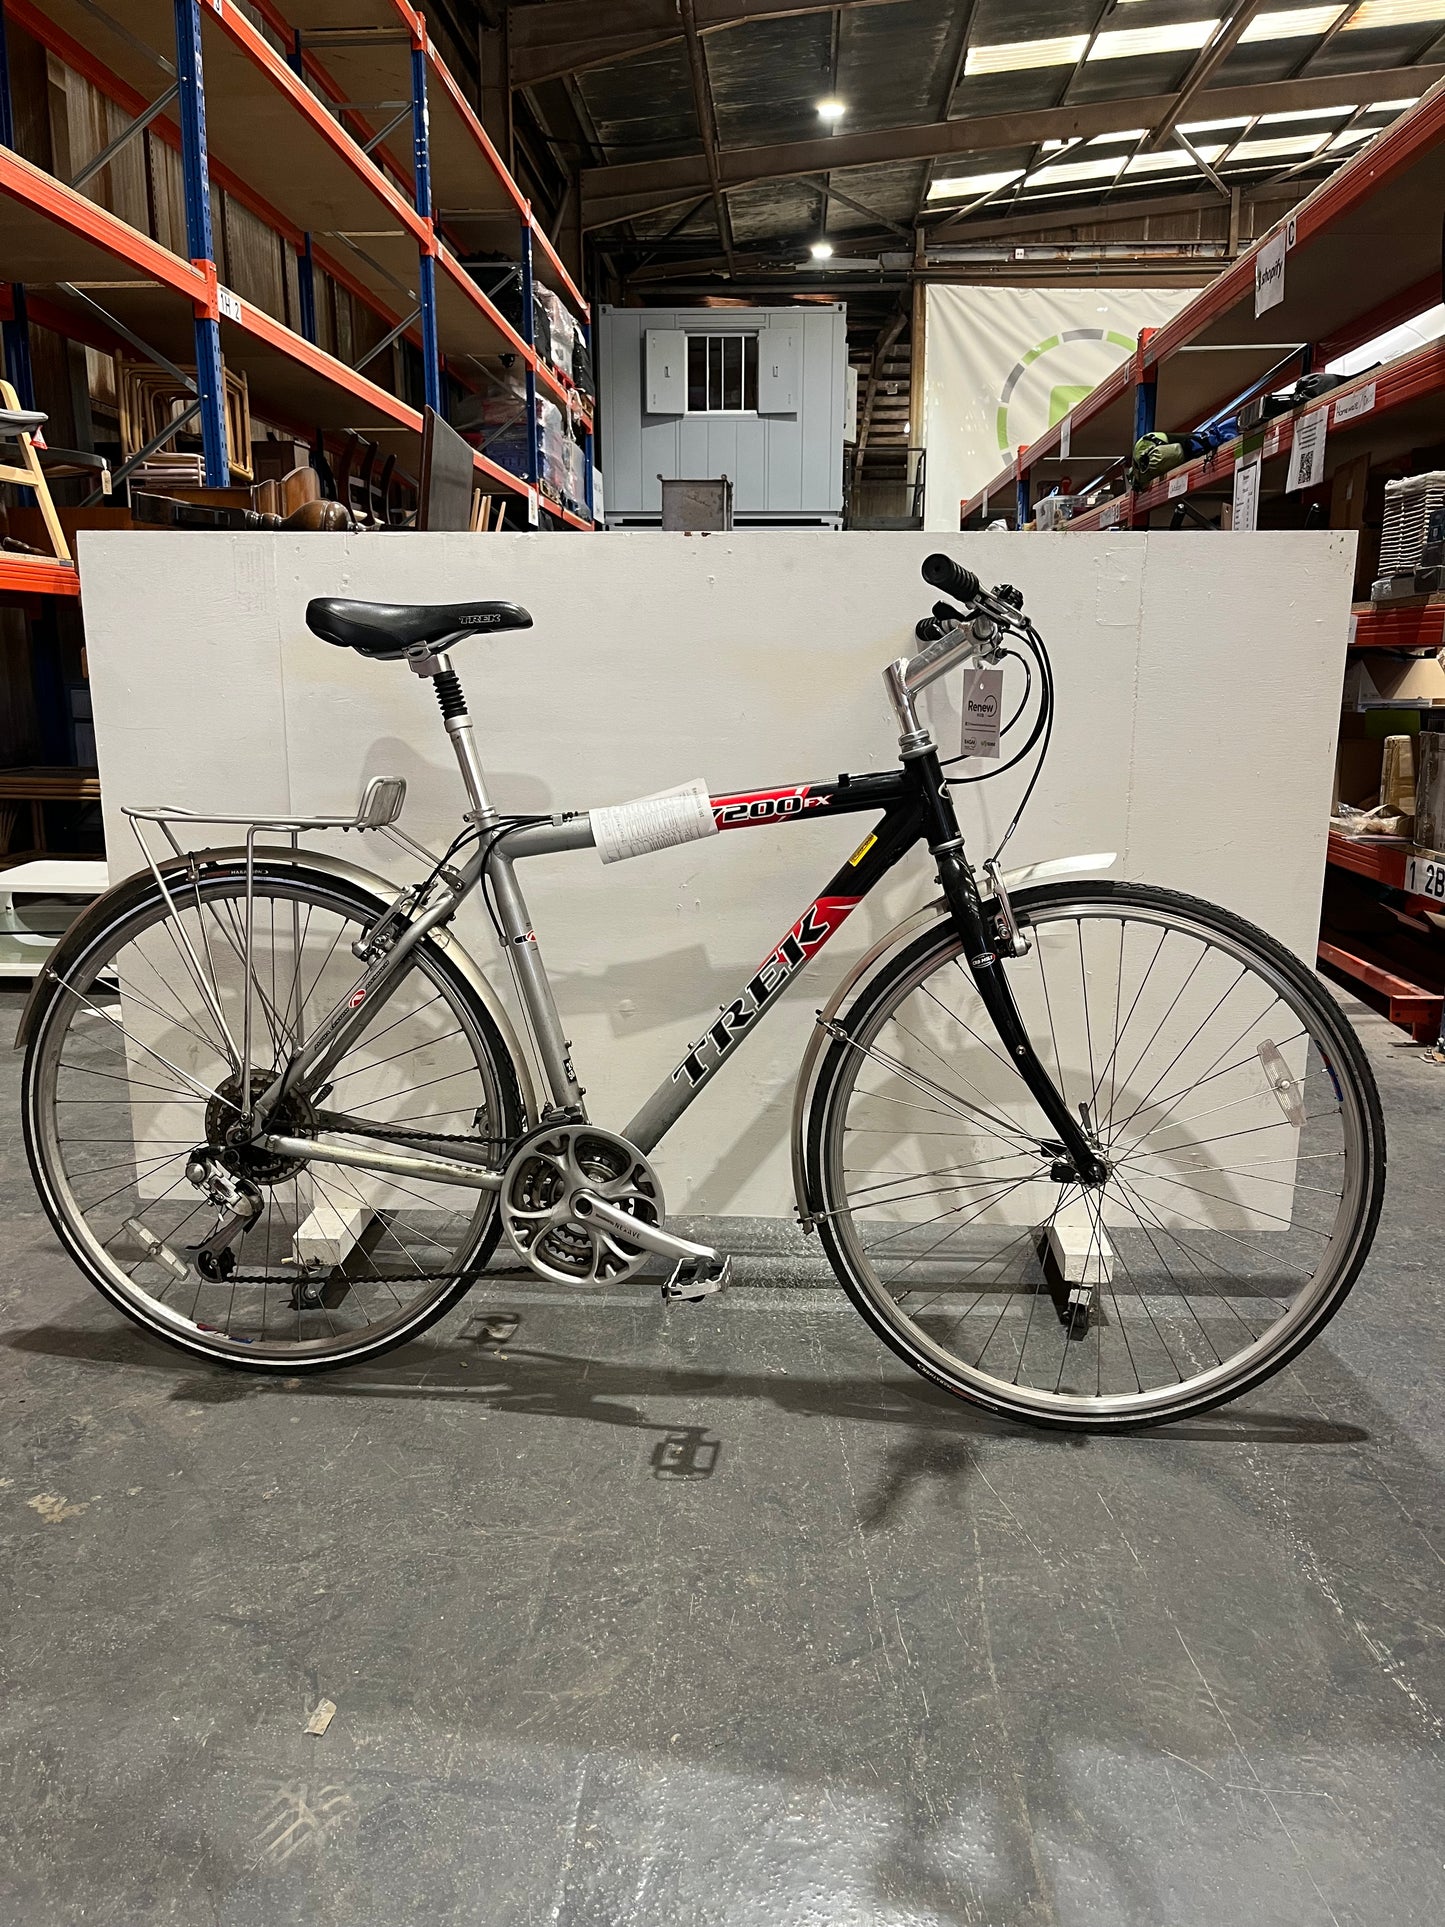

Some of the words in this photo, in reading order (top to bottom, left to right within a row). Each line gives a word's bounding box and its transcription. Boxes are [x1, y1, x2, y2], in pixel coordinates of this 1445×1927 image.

[1288, 221, 1295, 246] C
[1261, 258, 1283, 284] shopify
[220, 293, 231, 315] 1H
[235, 302, 240, 320] 2
[459, 614, 501, 624] TREK
[968, 701, 994, 713] Renew
[803, 794, 834, 808] FX
[1410, 861, 1416, 890] 1
[1425, 865, 1444, 897] 2B
[672, 904, 830, 1088] TREK
